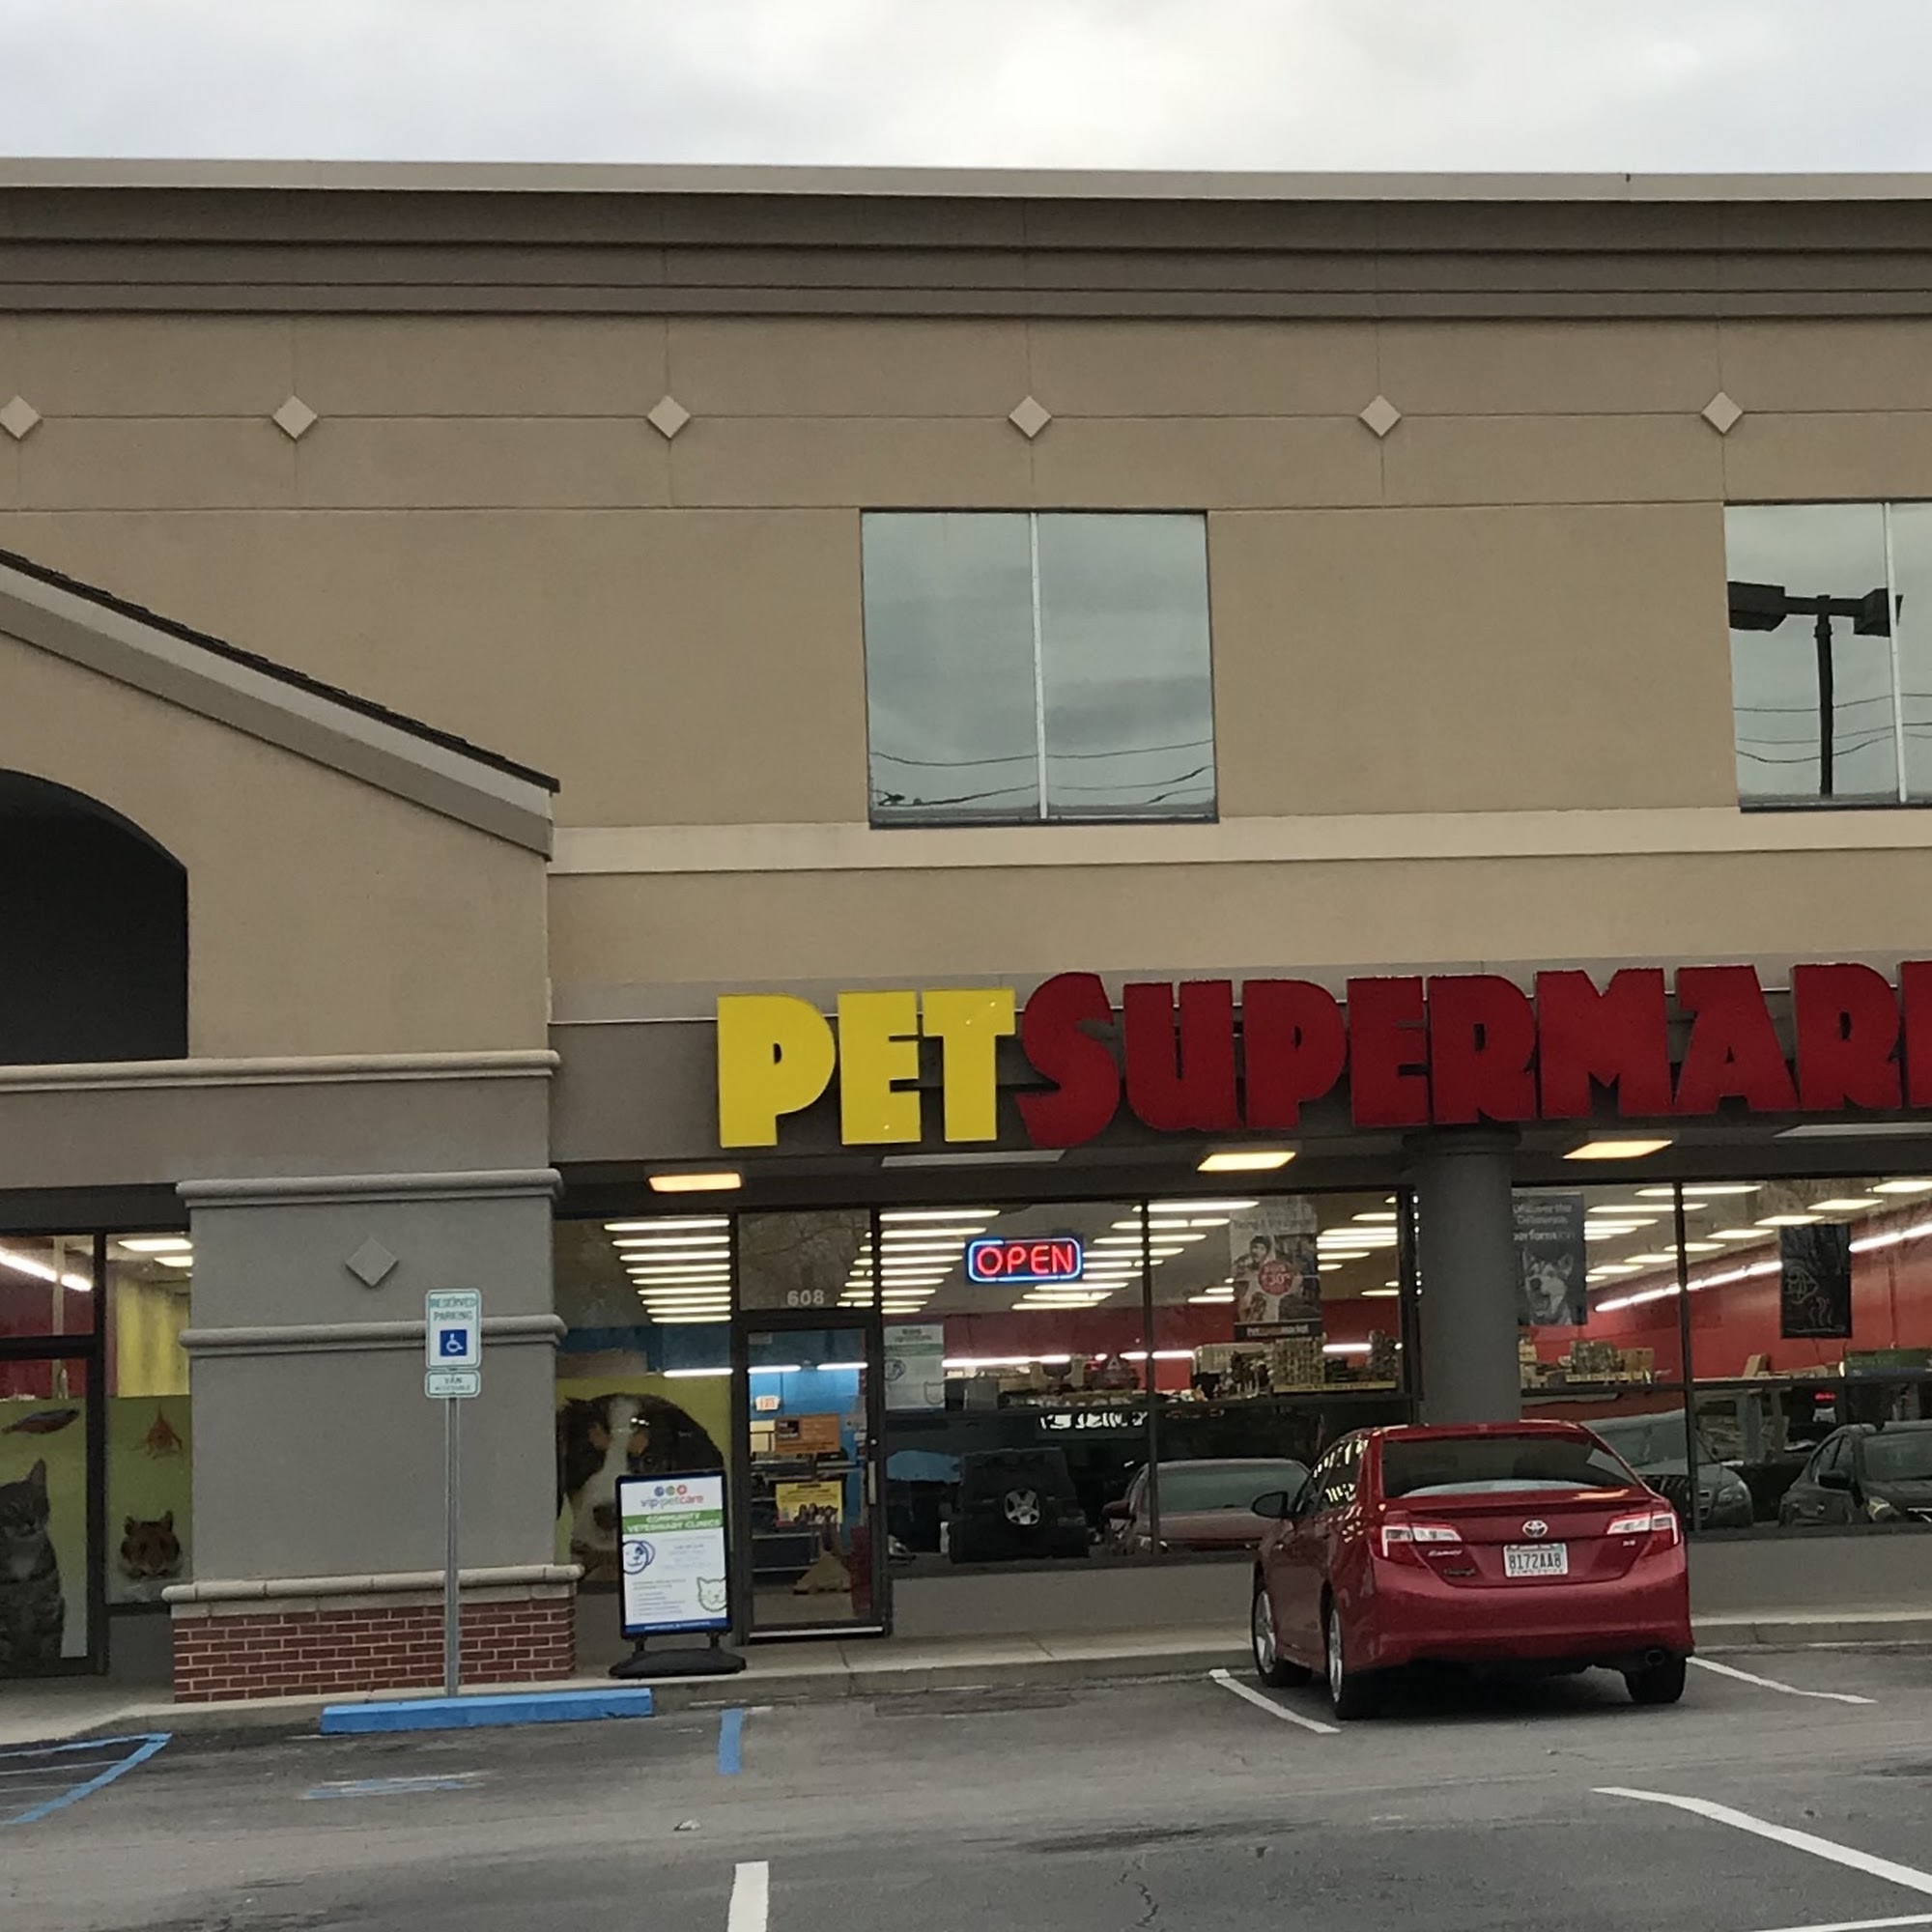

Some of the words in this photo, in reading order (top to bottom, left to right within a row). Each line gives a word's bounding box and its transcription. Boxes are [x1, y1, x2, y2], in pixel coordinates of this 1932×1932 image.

[717, 988, 1015, 1149] PET
[977, 1244, 1073, 1275] OPEN
[429, 1296, 478, 1309] RESERVED
[786, 1289, 825, 1306] 608
[433, 1310, 474, 1321] PARKING
[645, 1511, 700, 1524] COMMUNITY
[626, 1521, 683, 1534] VETERINARY
[684, 1518, 721, 1529] CLINICS
